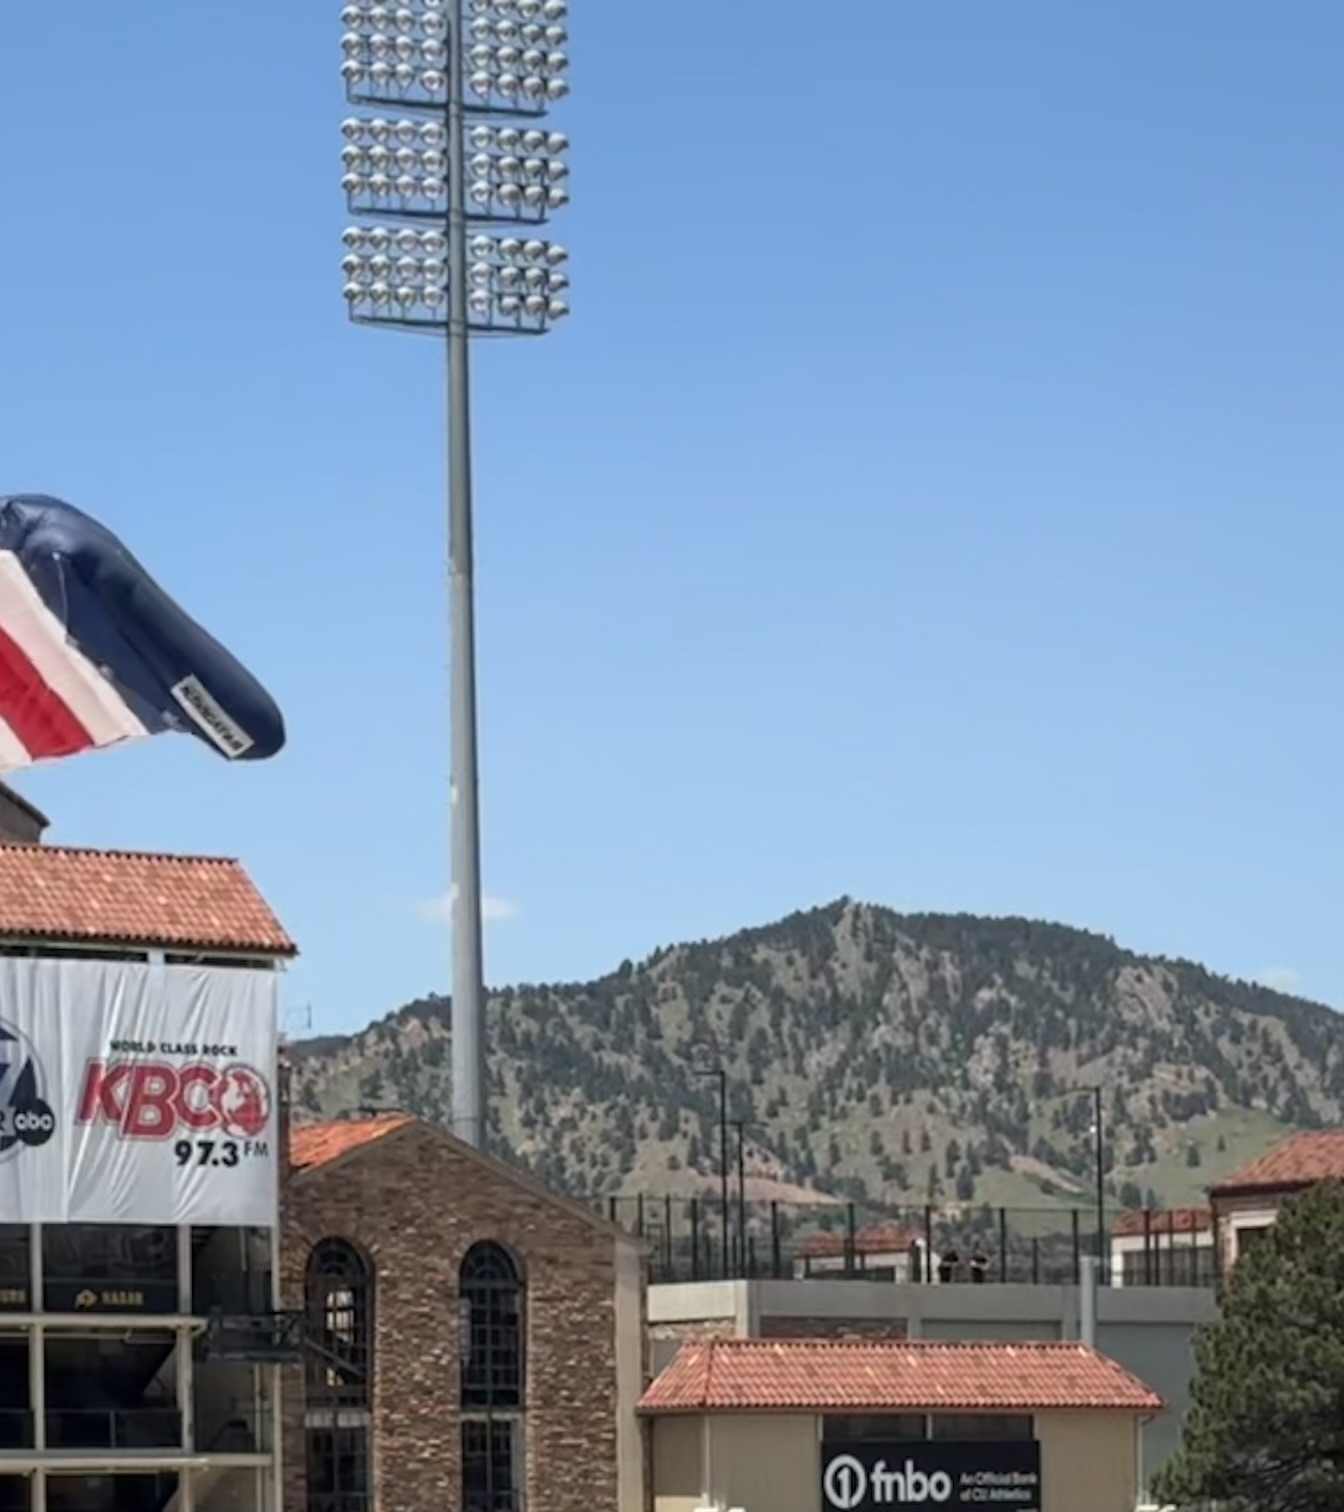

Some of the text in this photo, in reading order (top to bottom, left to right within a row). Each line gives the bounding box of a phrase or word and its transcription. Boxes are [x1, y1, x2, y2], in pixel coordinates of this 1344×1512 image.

[110, 1040, 237, 1056] WORLD CLASS ROCK
[13, 1112, 53, 1131] abc
[175, 1140, 269, 1167] 97.3 FM
[870, 1459, 952, 1502] fnbo
